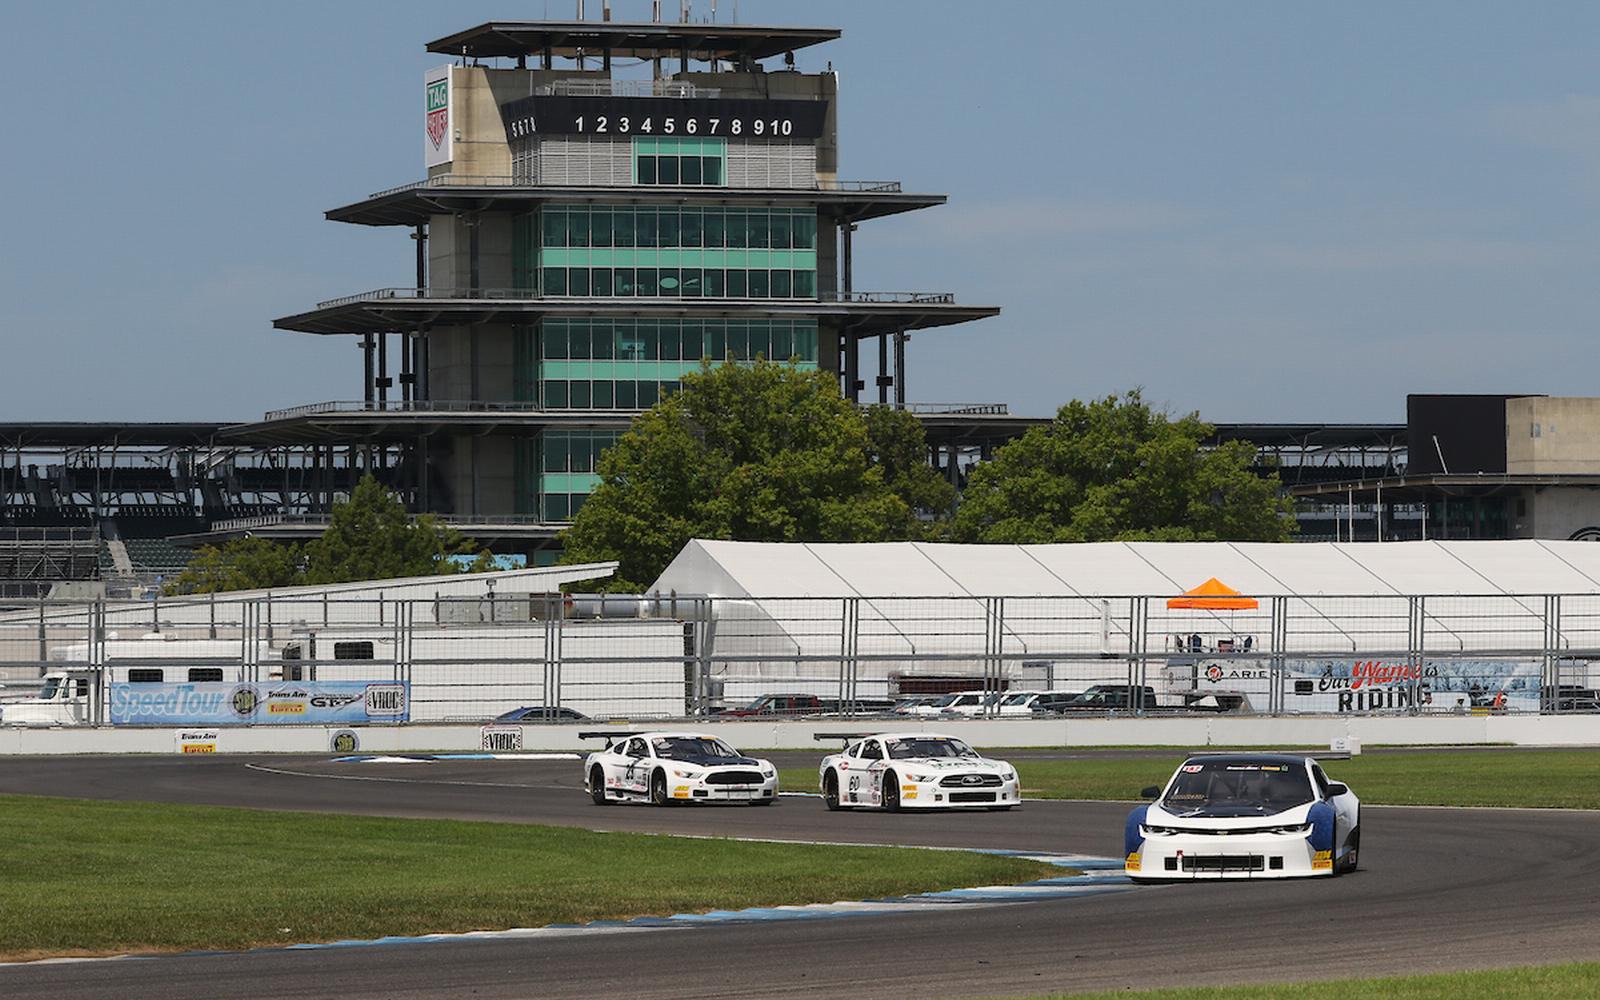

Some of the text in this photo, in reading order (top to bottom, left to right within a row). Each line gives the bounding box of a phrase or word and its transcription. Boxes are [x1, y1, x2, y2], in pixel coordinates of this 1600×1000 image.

[429, 86, 446, 109] TAG
[511, 122, 518, 137] 5
[518, 120, 524, 135] 6
[523, 119, 529, 134] 7
[575, 116, 792, 135] 1 2 3 4 5 6 7 8 9 10
[1319, 661, 1438, 691] Our Name is
[1339, 684, 1432, 711] RIDING
